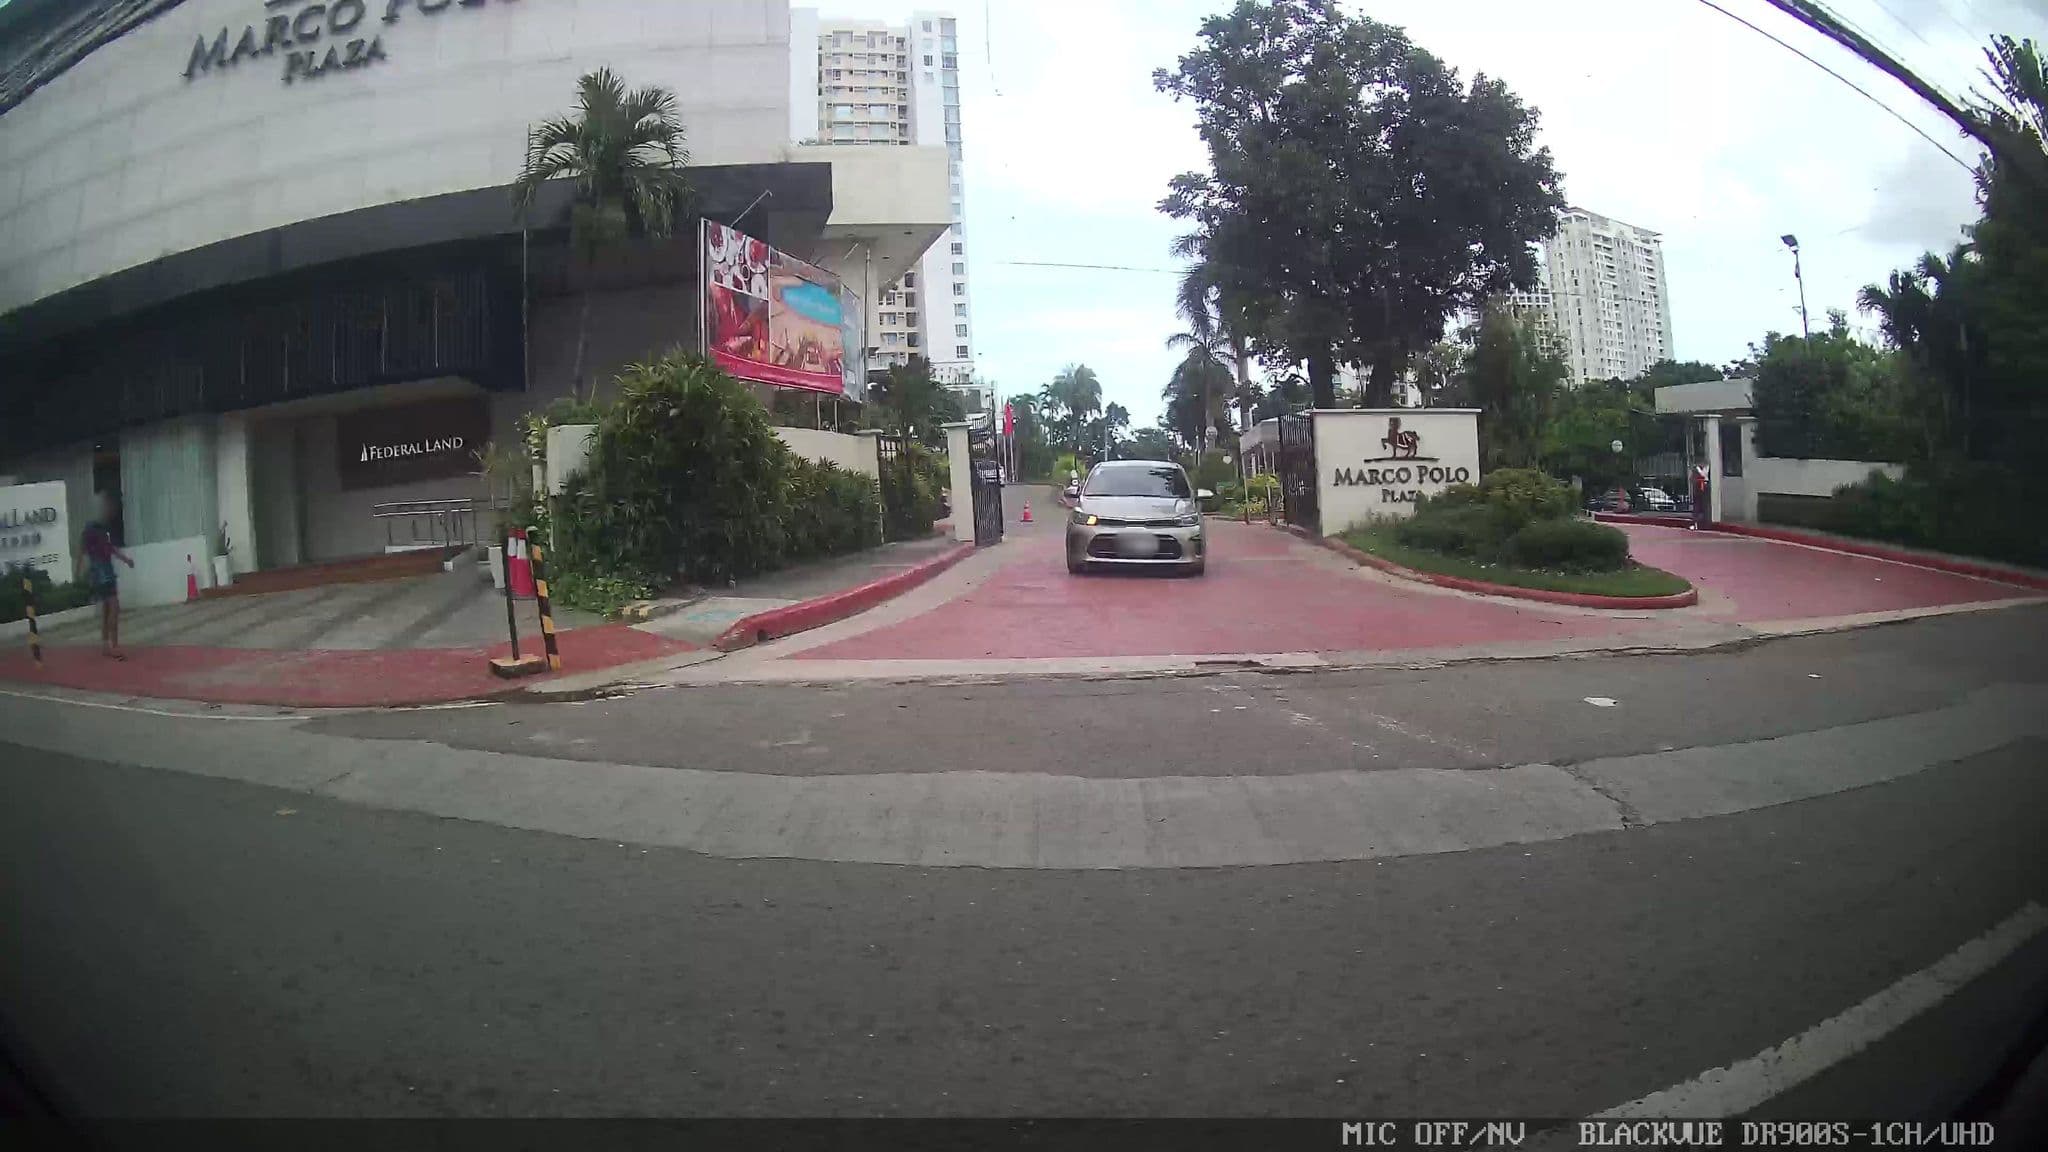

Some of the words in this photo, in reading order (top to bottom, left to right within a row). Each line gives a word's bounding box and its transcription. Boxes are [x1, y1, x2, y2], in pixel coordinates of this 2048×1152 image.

[180, 0, 366, 78] MARCO
[282, 36, 387, 83] PLAZA
[369, 443, 423, 460] FEDERAL
[425, 436, 463, 452] LAND
[1333, 466, 1412, 486] MARCO
[1416, 465, 1469, 484] POLO
[1382, 488, 1417, 503] PLAZ
